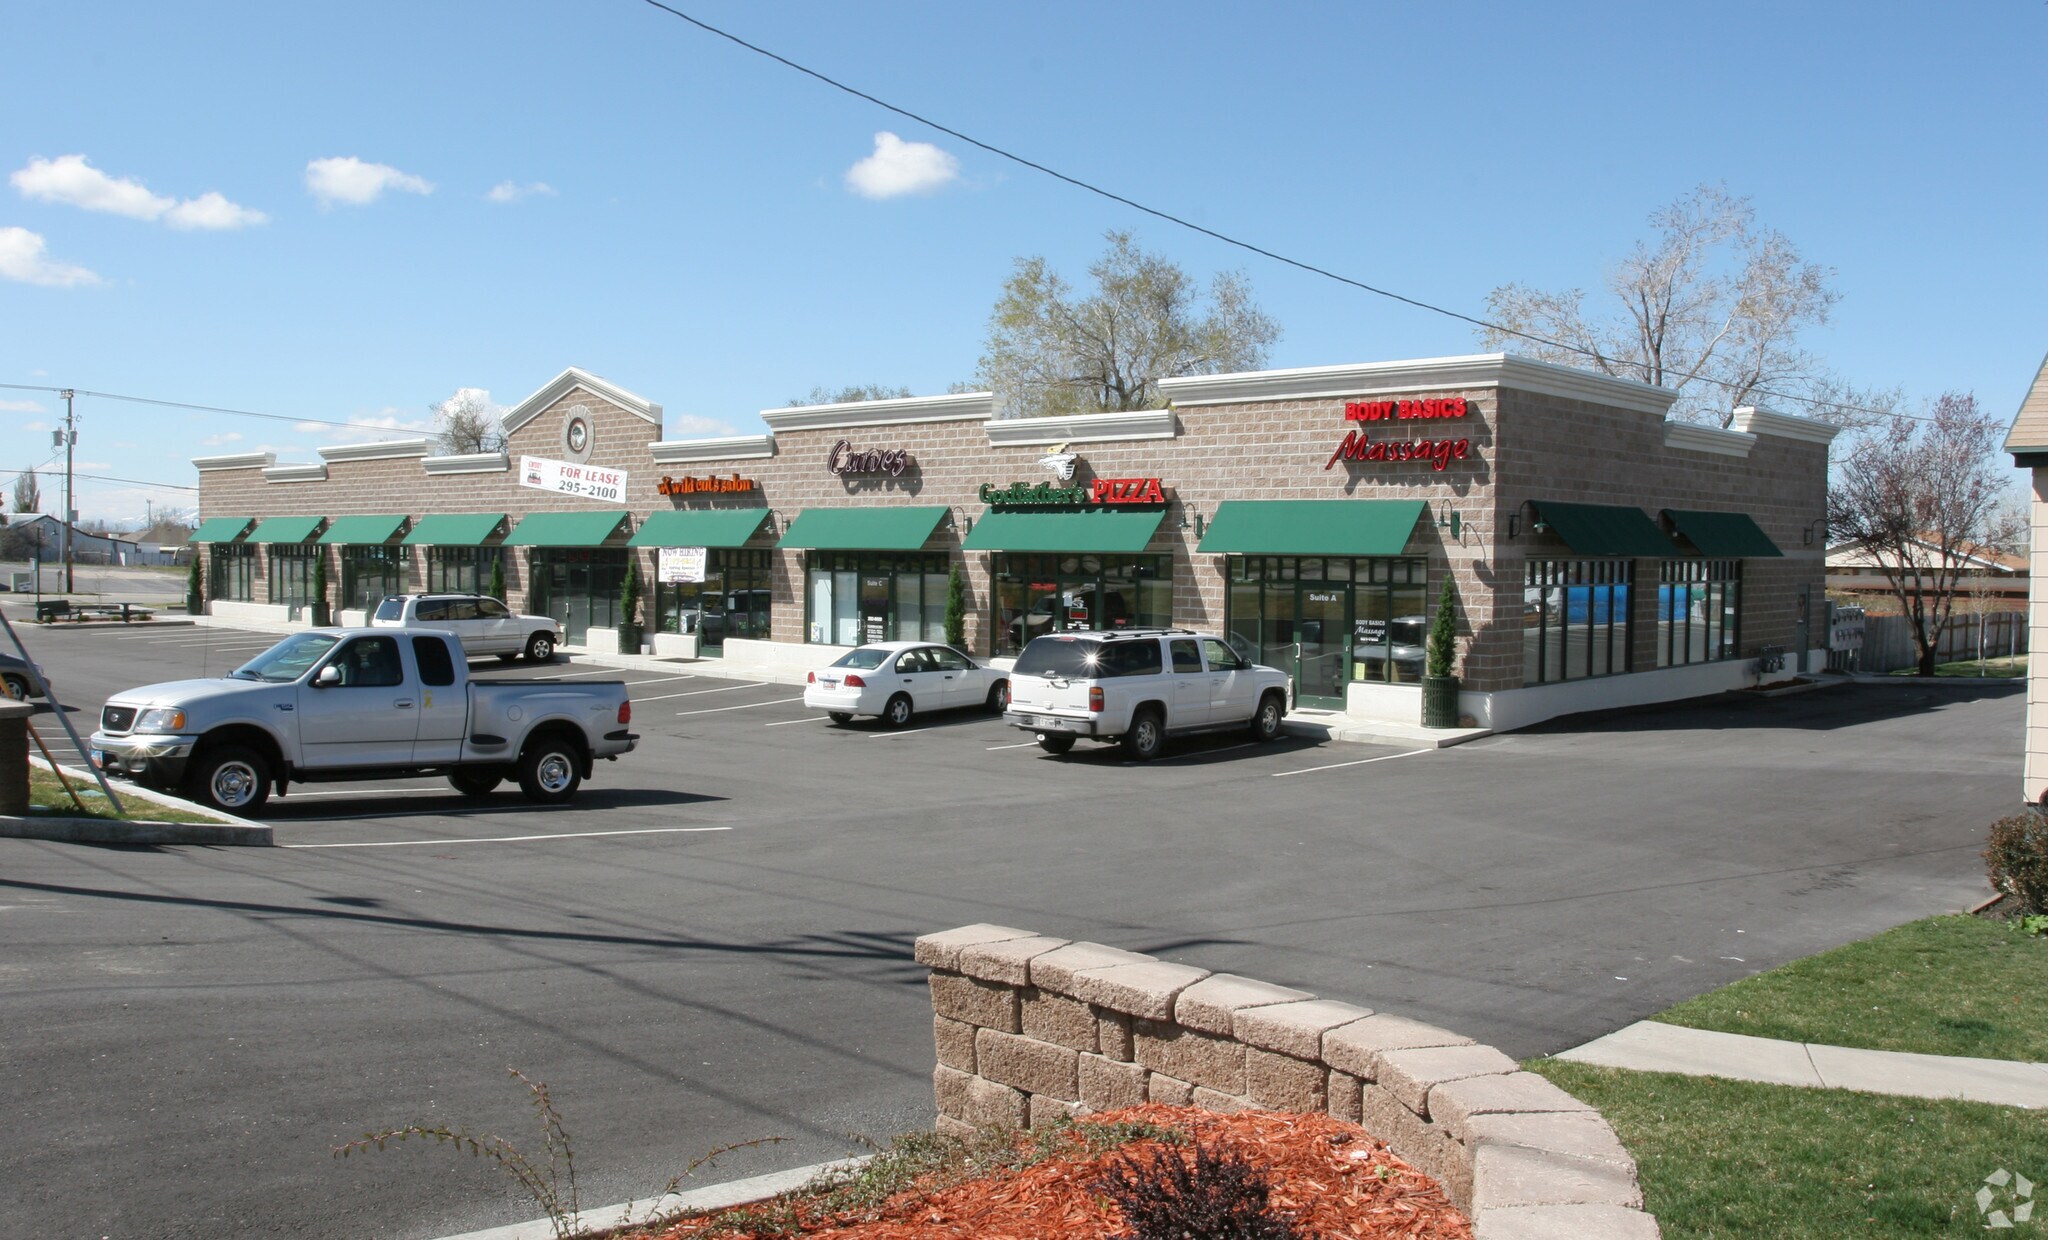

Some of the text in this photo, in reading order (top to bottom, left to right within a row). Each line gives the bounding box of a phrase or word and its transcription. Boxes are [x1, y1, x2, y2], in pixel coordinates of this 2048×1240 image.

[1345, 397, 1467, 421] BODY BASICS
[827, 440, 907, 477] Curves
[1325, 430, 1469, 472] Massage
[560, 466, 621, 486] FOR LEASE
[558, 480, 618, 499] 295-2100
[978, 477, 1165, 505] Godfather's PIZZA
[662, 547, 704, 557] NOW HIRING
[1309, 593, 1337, 602] Suite A
[1354, 625, 1386, 637] Massage
